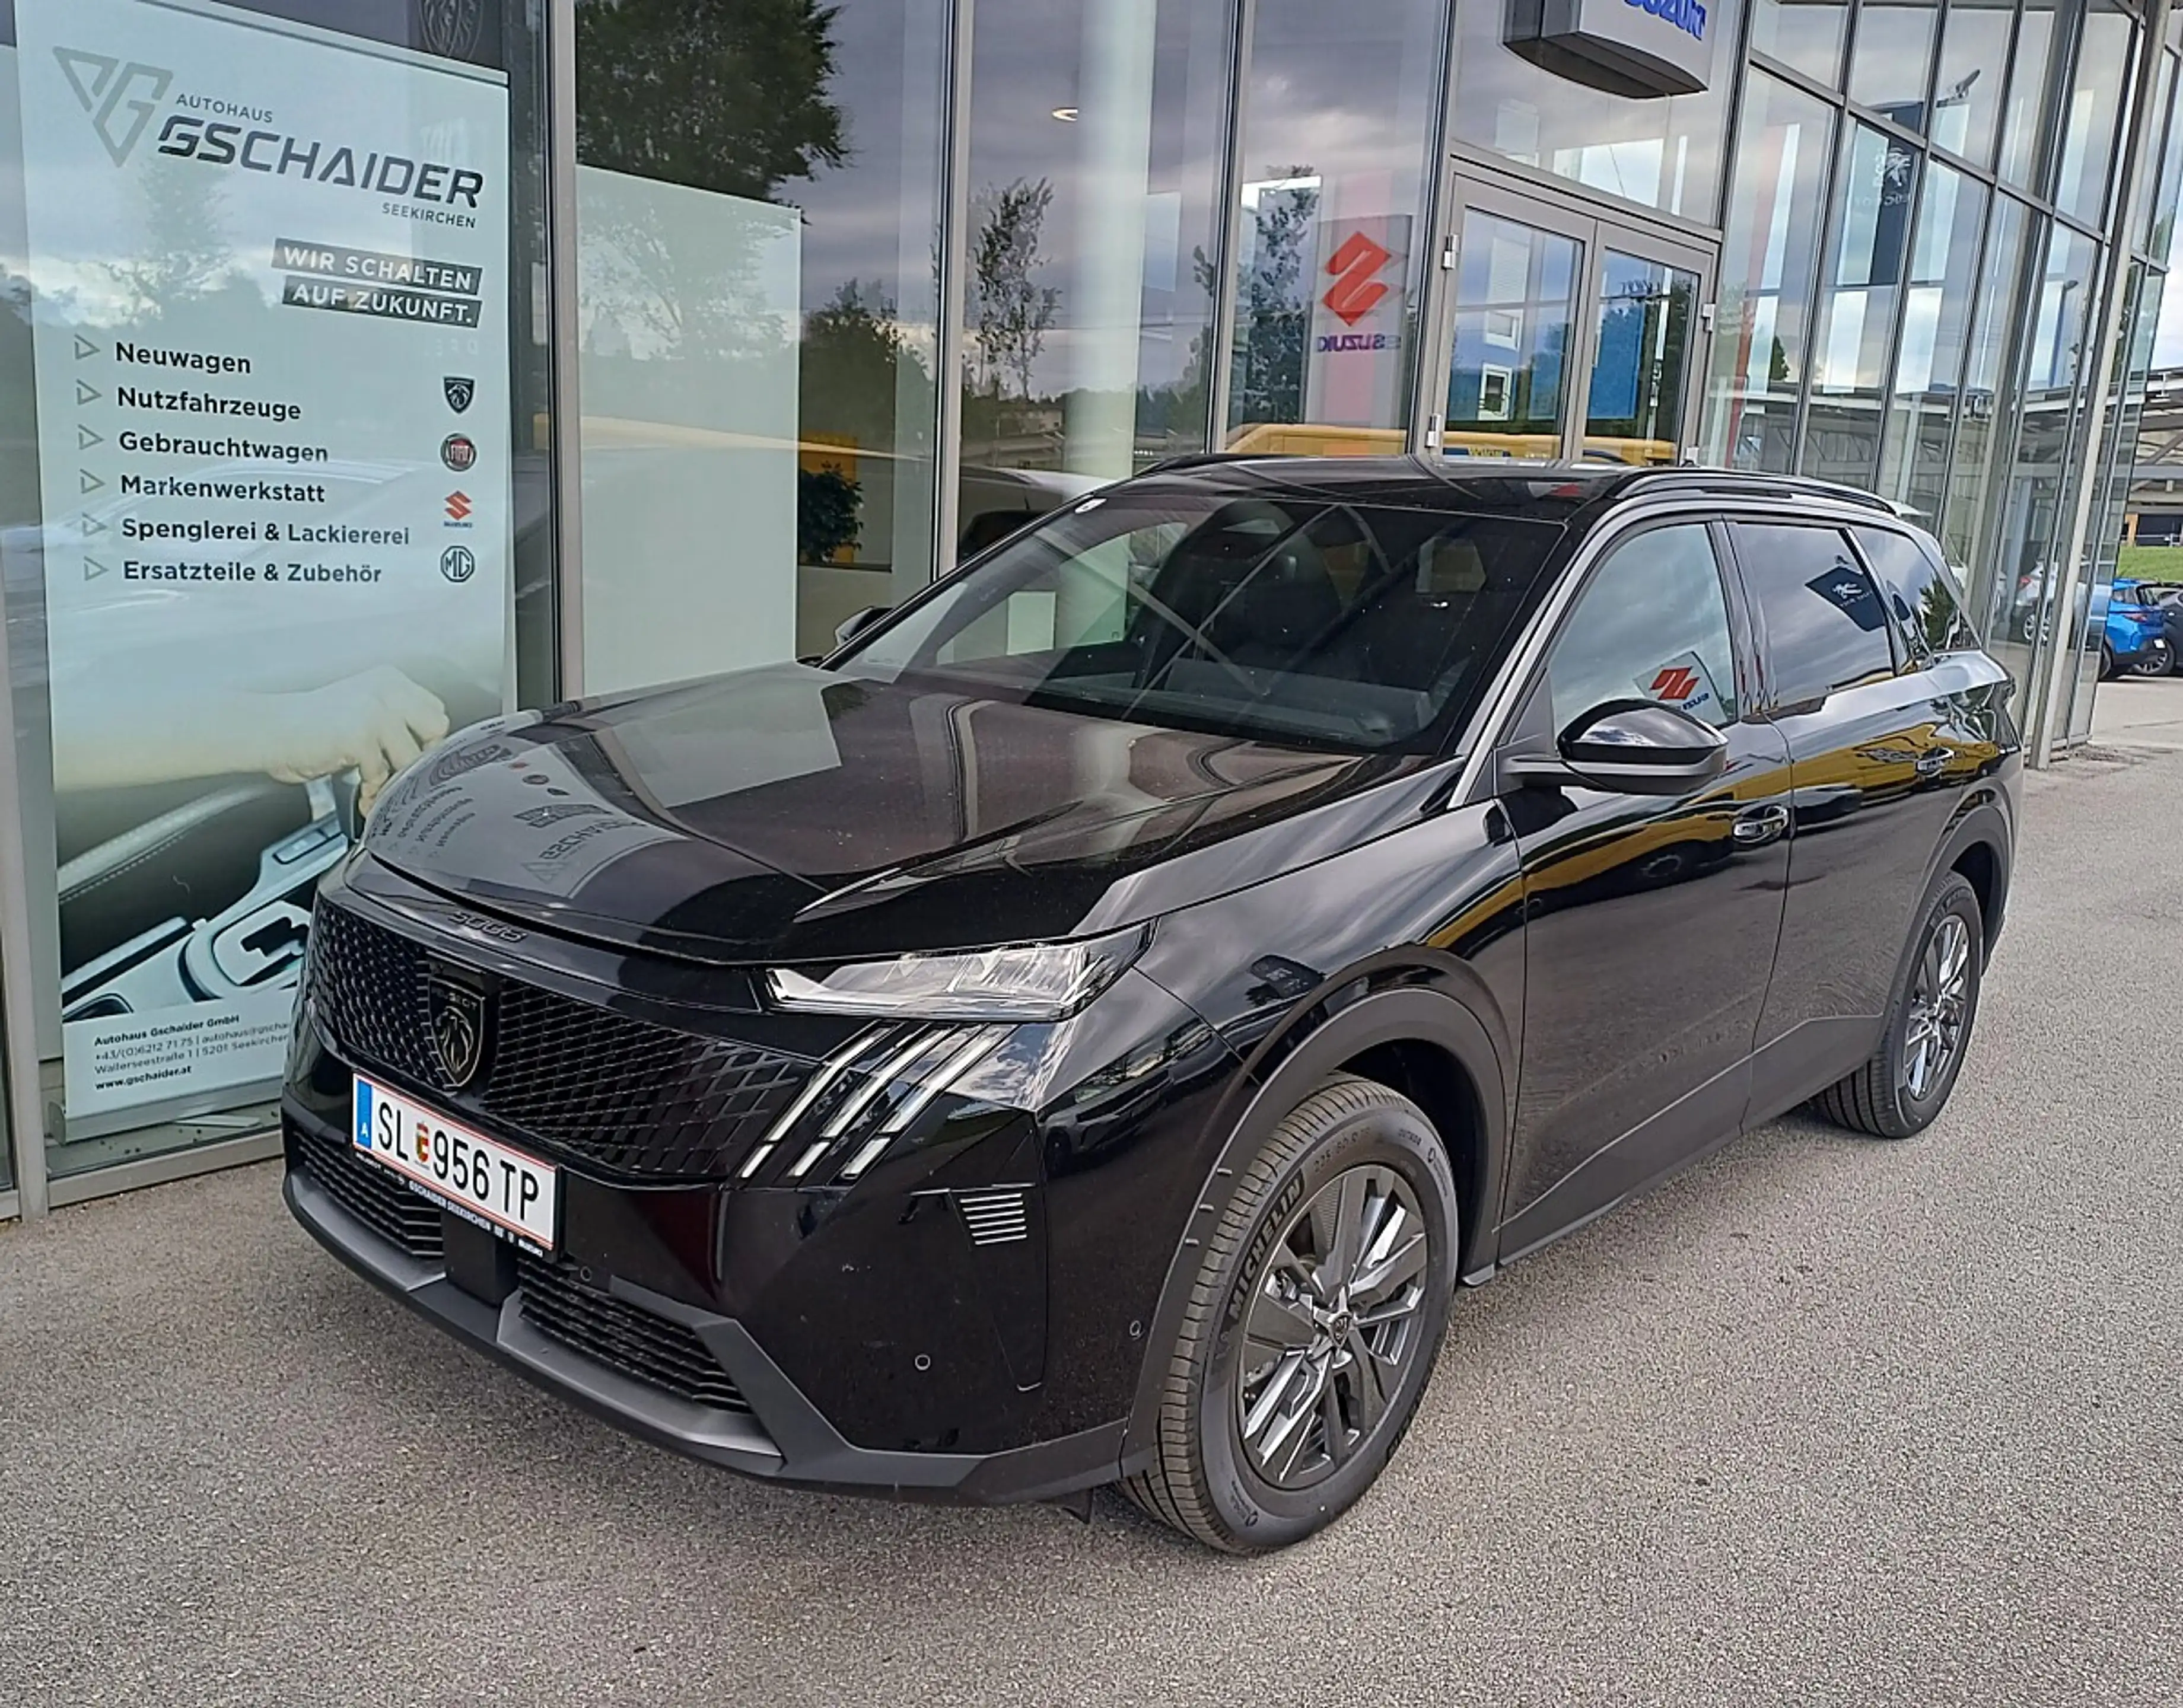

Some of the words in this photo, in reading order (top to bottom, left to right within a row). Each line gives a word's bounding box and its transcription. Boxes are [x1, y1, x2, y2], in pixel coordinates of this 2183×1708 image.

[176, 93, 273, 123] AUTOHAUS
[158, 114, 483, 209] GSCHAIDER
[382, 202, 476, 228] SEEKIRCHEN
[283, 246, 334, 272] WIR
[345, 255, 473, 290] SCHALTEN
[292, 283, 345, 308] AUF
[355, 290, 473, 323] ZUKUNFT.
[116, 342, 252, 374] Neuwagen
[117, 387, 301, 421] Nutzfahrzeuge
[119, 432, 329, 464] Gebrauchtwagen
[122, 476, 326, 503] Markenwerkstatt
[122, 518, 256, 541] Spenglerei
[265, 524, 280, 541] &
[288, 524, 409, 545] Lackiererei
[123, 562, 256, 581] Ersatzteile
[265, 565, 279, 581] &
[287, 563, 381, 582] Zubehör
[445, 551, 470, 576] MG
[448, 911, 529, 942] 5008
[94, 1031, 147, 1046] Autohaus
[151, 1020, 203, 1037] Gschaider
[207, 1014, 240, 1028] GmbH
[95, 1065, 192, 1090] www.gschaider.at
[361, 1123, 368, 1137] A
[378, 1101, 409, 1162] SL
[433, 1129, 489, 1202] 956
[499, 1159, 539, 1221] TP
[1228, 1178, 1303, 1321] MICHELIN
